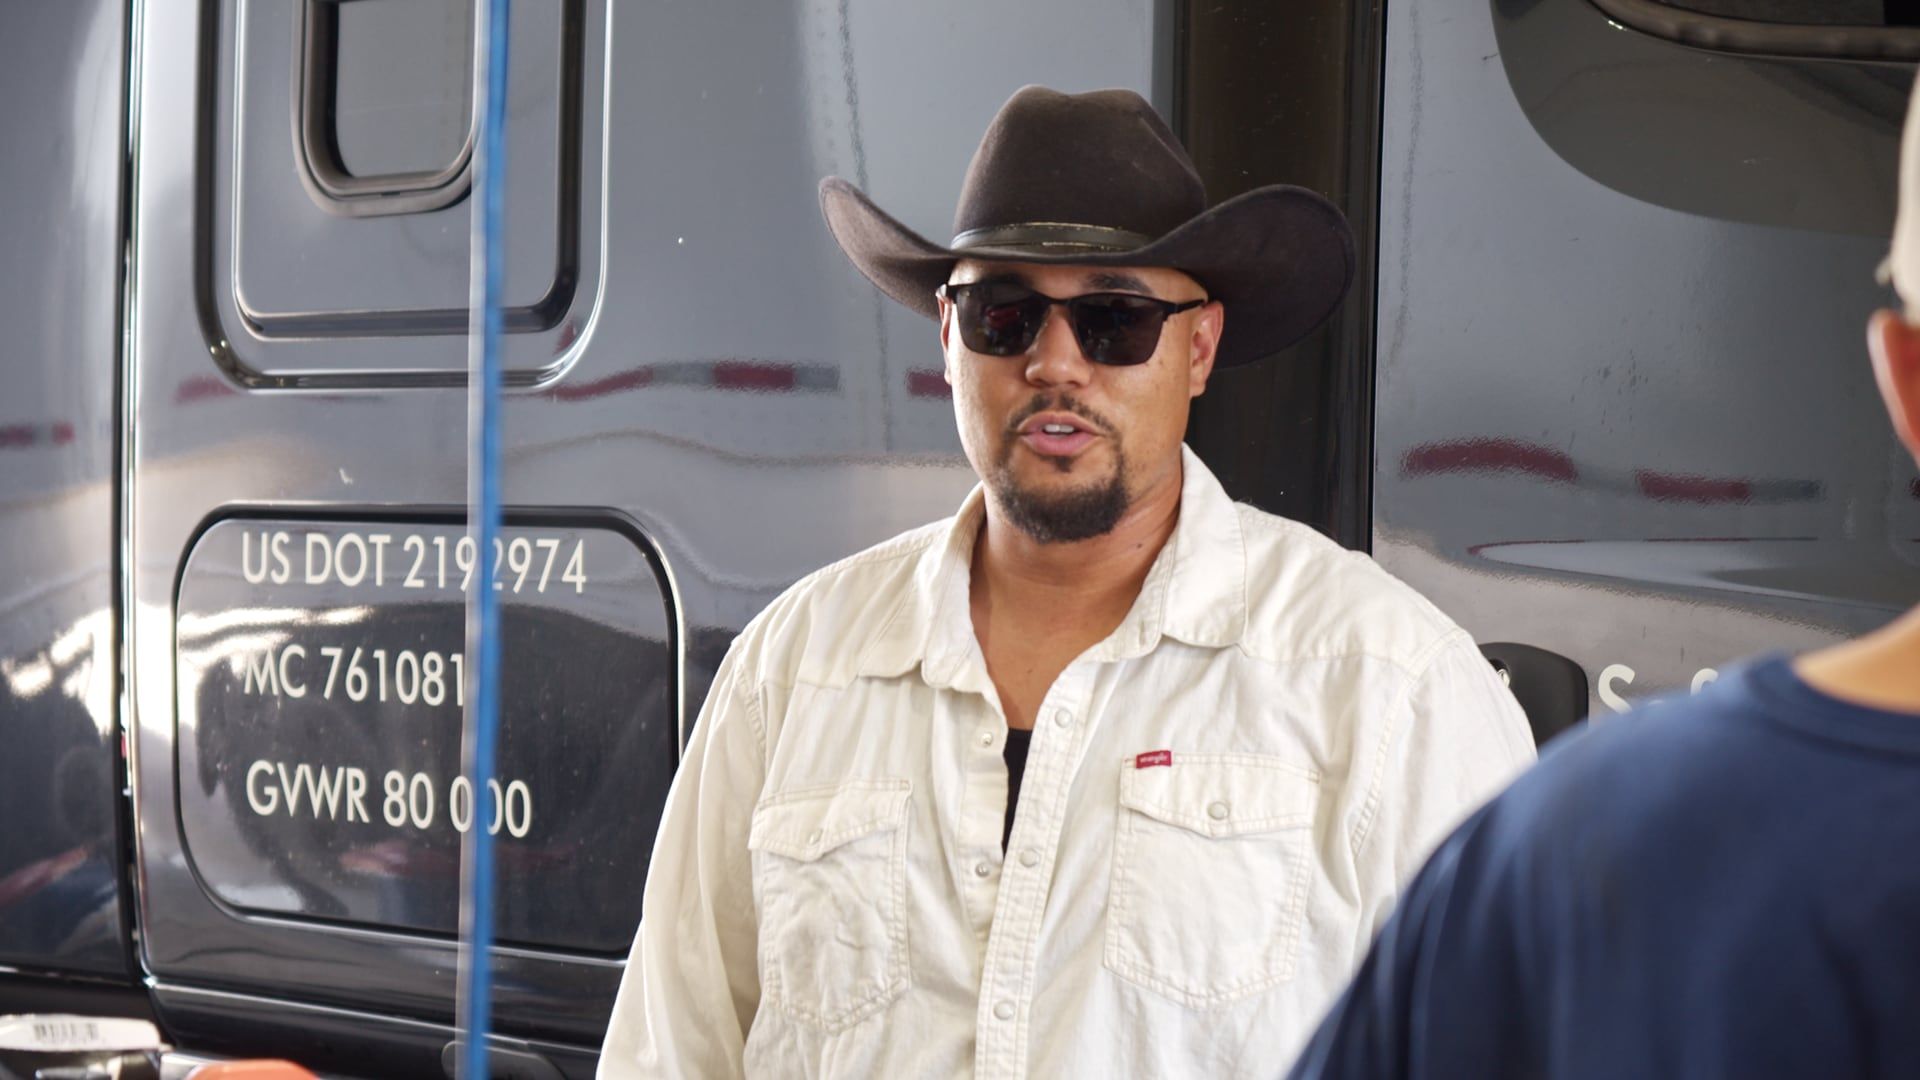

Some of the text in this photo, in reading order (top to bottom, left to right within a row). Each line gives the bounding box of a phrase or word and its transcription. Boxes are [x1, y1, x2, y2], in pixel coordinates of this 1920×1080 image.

[242, 531, 290, 584] US
[305, 532, 392, 587] DOT
[243, 644, 464, 707] MC 761081
[246, 759, 532, 838] GVWR 80 000
